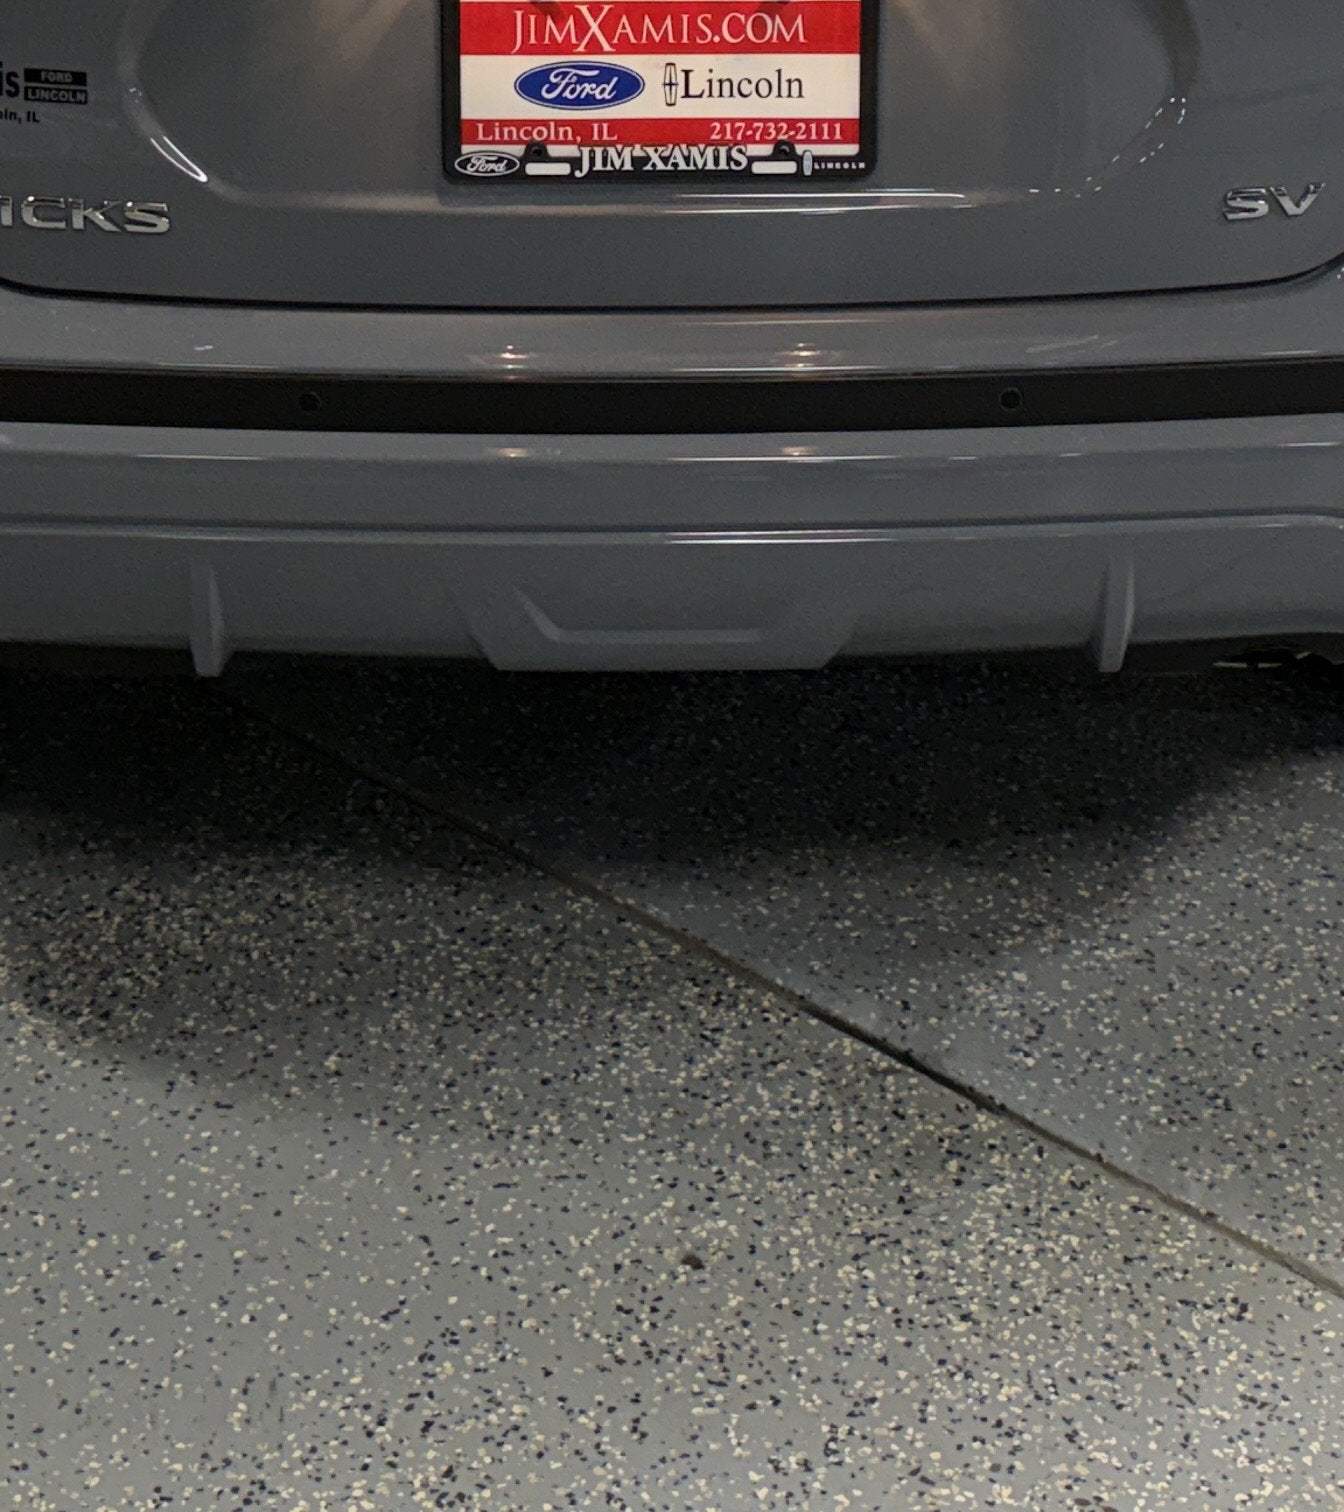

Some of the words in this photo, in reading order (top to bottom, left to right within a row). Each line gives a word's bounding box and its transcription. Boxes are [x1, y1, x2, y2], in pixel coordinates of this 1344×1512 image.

[511, 3, 807, 55] JIMXAMIS.COM
[41, 71, 72, 83] FORD
[541, 68, 618, 101] Ford
[680, 68, 806, 99] Lincoln
[28, 88, 86, 103] LINCOLN
[27, 109, 40, 123] IL
[476, 122, 582, 144] Lincoln,
[592, 122, 618, 141] IL
[710, 121, 843, 141] 217-732-2111
[467, 155, 508, 173] Ford
[574, 145, 634, 178] JIM
[642, 144, 749, 171] XAMIS
[1223, 182, 1326, 221] SV
